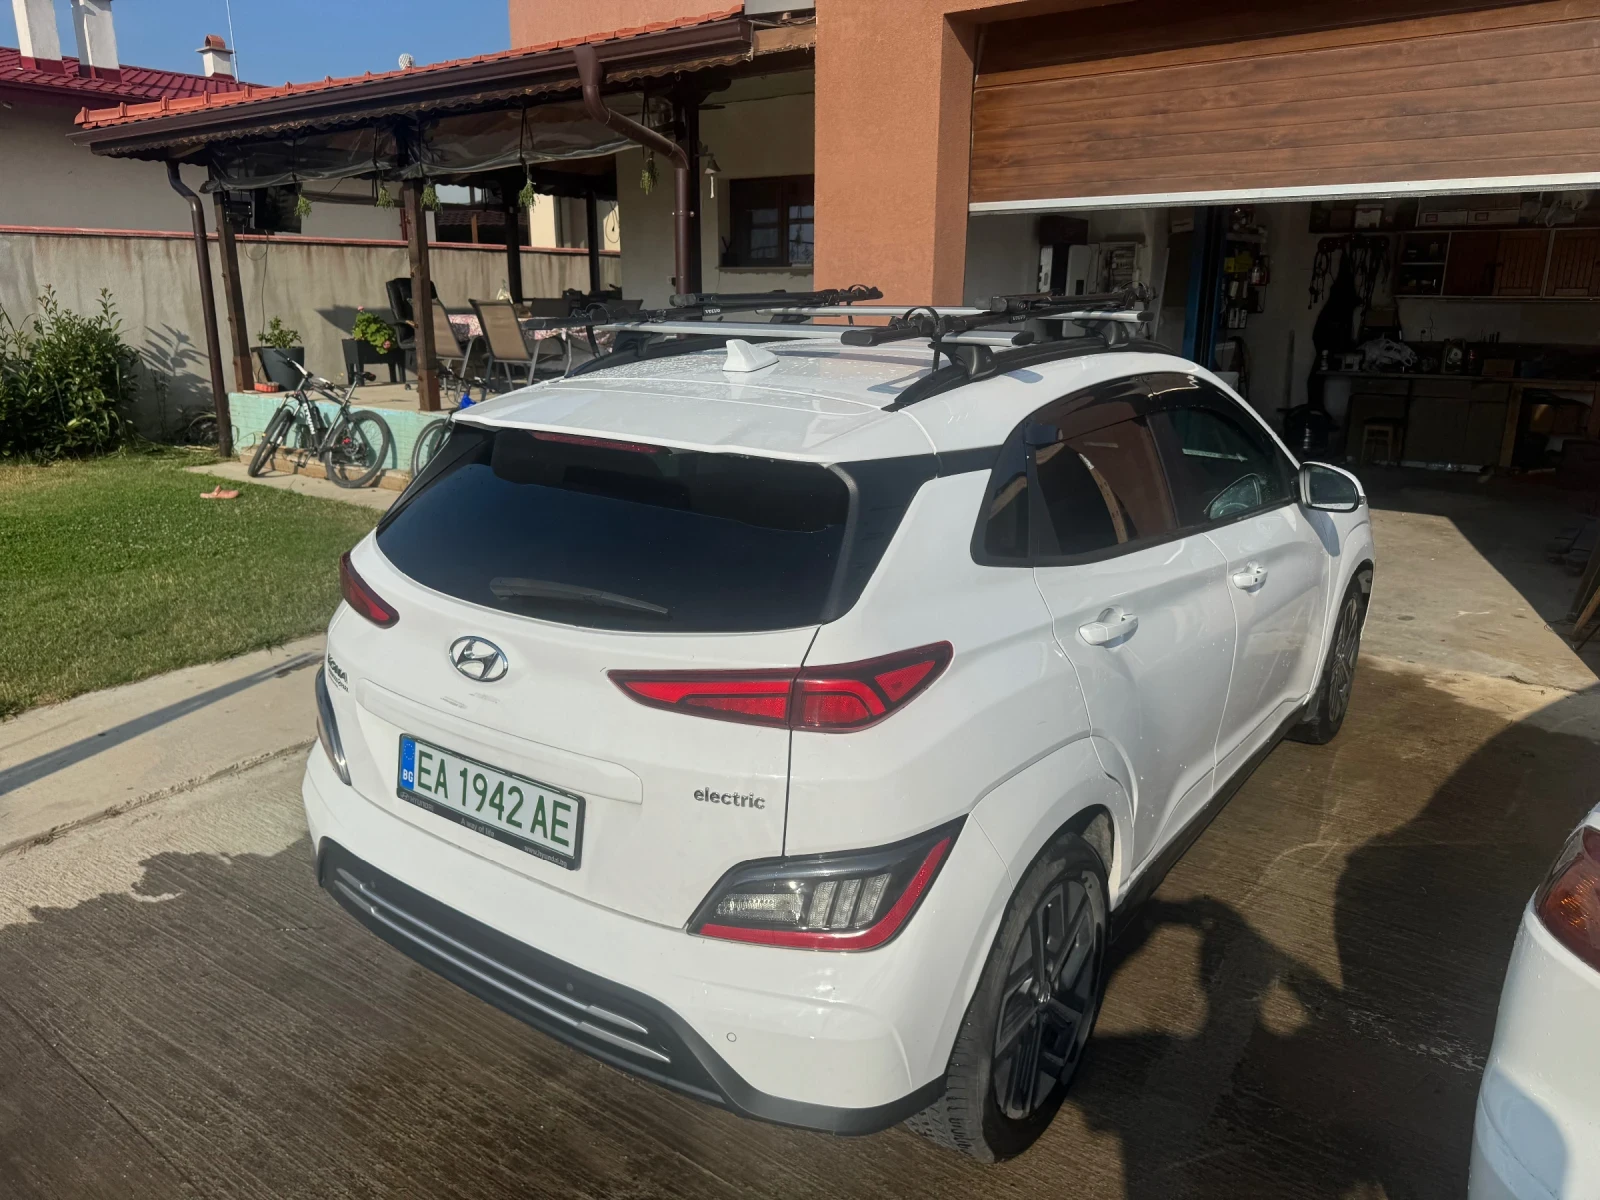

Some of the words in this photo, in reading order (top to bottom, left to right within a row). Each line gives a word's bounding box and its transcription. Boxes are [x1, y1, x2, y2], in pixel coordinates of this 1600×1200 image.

[402, 769, 414, 782] BG
[418, 750, 448, 799] EA
[459, 767, 524, 829] 1942
[530, 795, 571, 847] AE
[694, 787, 765, 809] electric
